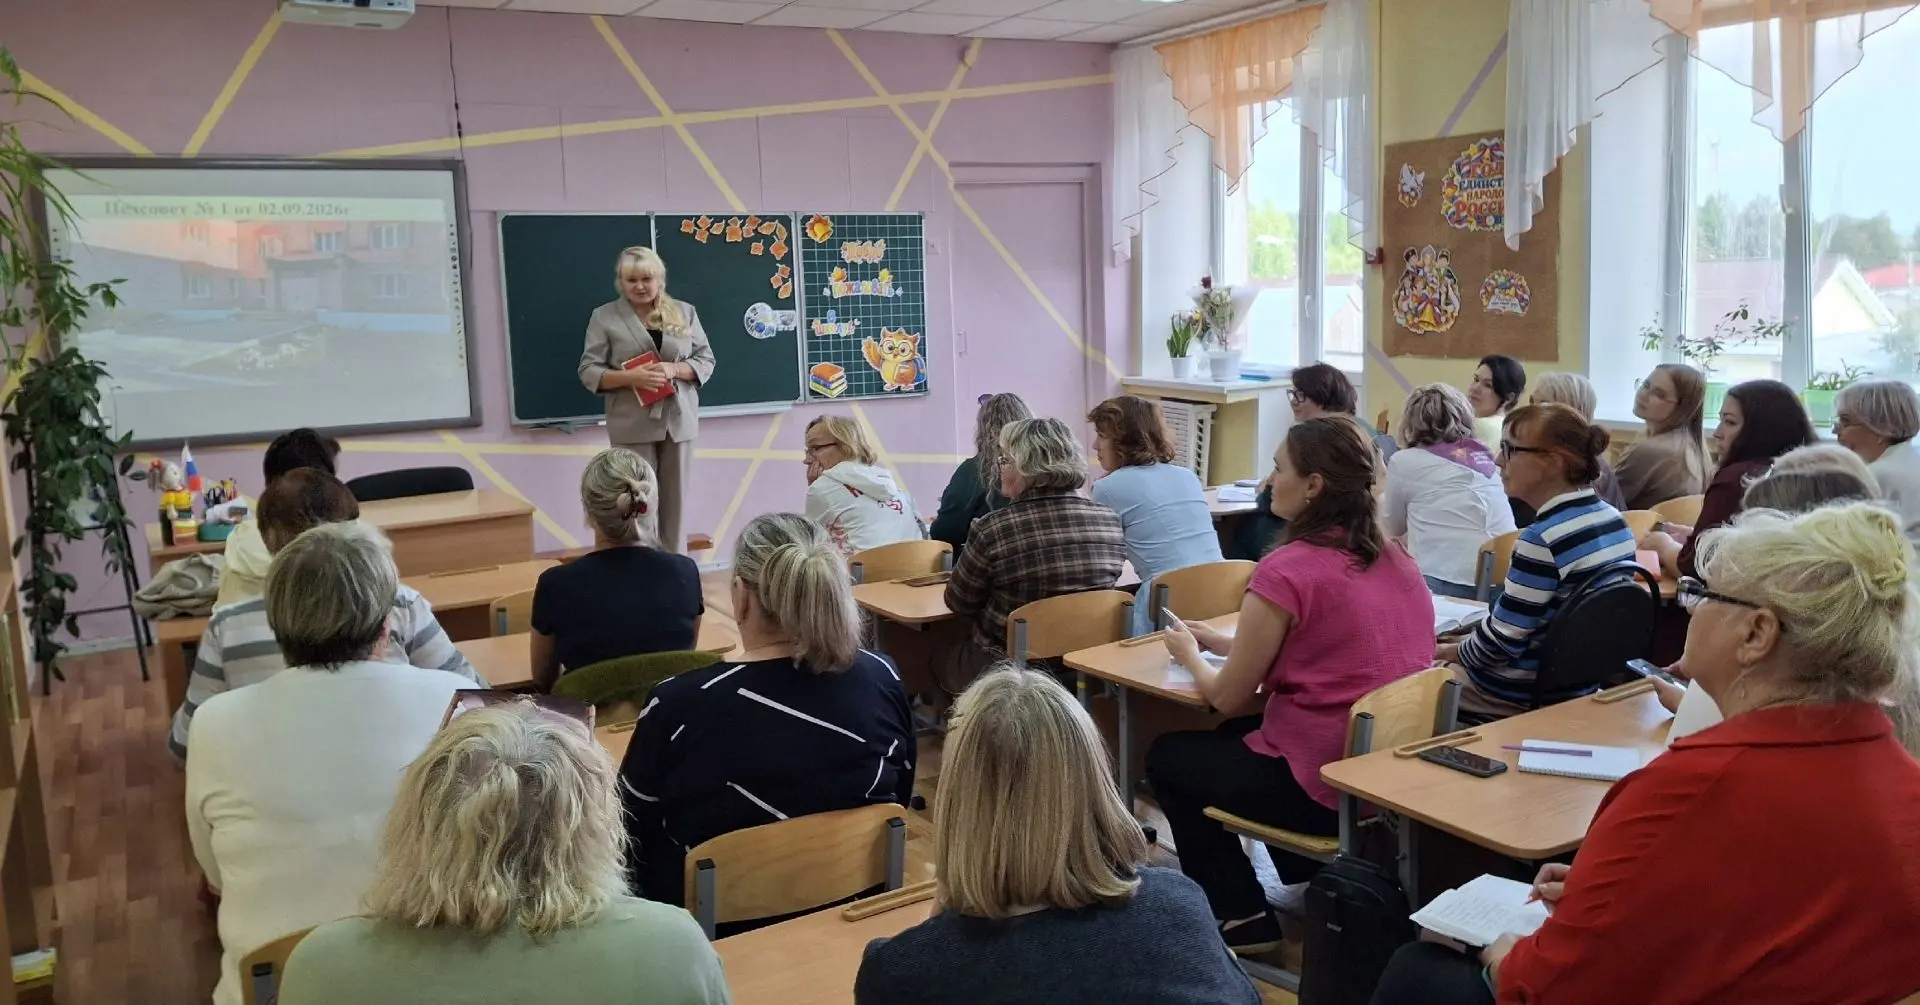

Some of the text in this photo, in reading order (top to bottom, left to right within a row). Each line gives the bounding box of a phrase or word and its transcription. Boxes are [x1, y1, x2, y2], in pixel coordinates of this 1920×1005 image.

[1459, 178, 1504, 191] ЕДИНСТ
[1466, 189, 1504, 201] НАРОДО
[191, 201, 213, 215] №
[221, 202, 227, 215] 1
[234, 205, 251, 215] от
[1455, 198, 1504, 218] РОССИ
